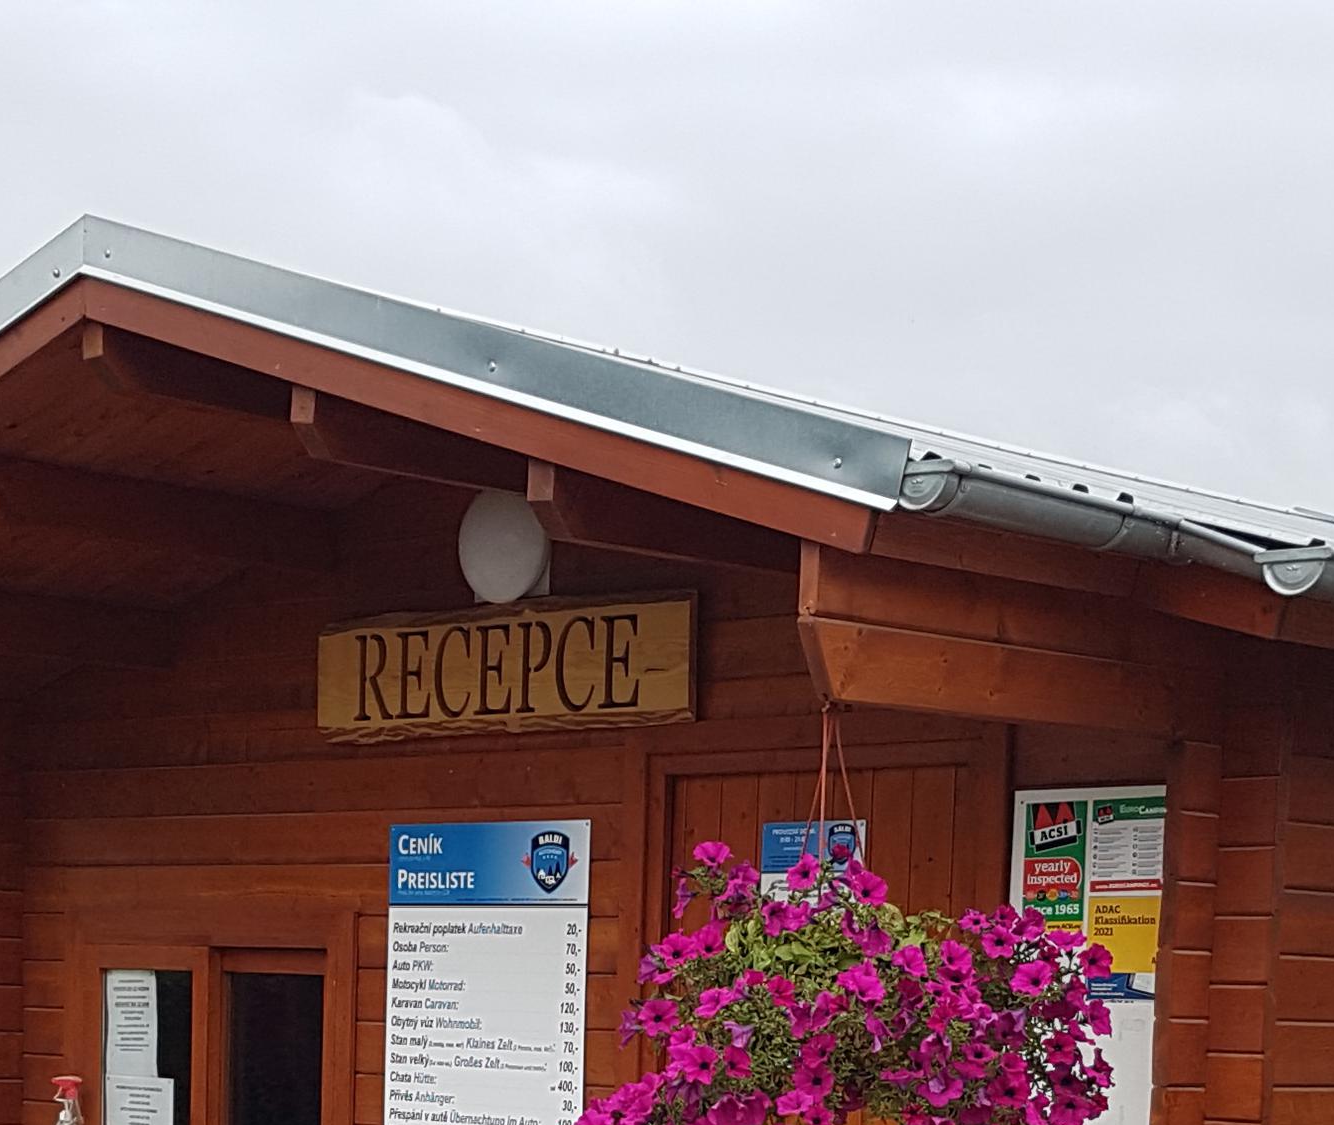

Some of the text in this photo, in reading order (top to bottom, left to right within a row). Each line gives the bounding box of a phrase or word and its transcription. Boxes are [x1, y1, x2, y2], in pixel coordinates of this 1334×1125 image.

[353, 613, 639, 722] RECEPCE
[1040, 826, 1069, 842] ACSI
[1034, 860, 1071, 875] yearly
[397, 869, 475, 889] PREISLISTE
[1027, 873, 1078, 886] inspected
[1055, 904, 1080, 915] 1965
[1095, 905, 1121, 914] ADAC
[1094, 917, 1156, 926] Klassifikation
[432, 923, 466, 936] poplatek
[567, 924, 582, 937] 20,-
[1094, 927, 1114, 936] 2021
[392, 941, 417, 953] Osoba
[566, 943, 581, 957] 70,-
[392, 960, 410, 971] Auto
[565, 963, 581, 977] 50,-
[392, 978, 426, 993] Motocykl
[564, 983, 580, 996] 50,-
[391, 997, 579, 1017] Karavan Caravan: 120,-
[560, 1022, 579, 1036] 130,-
[390, 1034, 408, 1045] Stan
[497, 1038, 513, 1050] Zelt
[563, 1042, 579, 1056] 70,-
[390, 1053, 407, 1064] Stan
[485, 1057, 500, 1069] Zelt
[559, 1061, 578, 1076] 100,-
[390, 1071, 412, 1083] Chata
[558, 1081, 578, 1096] 400,-
[562, 1100, 578, 1115] 30,-
